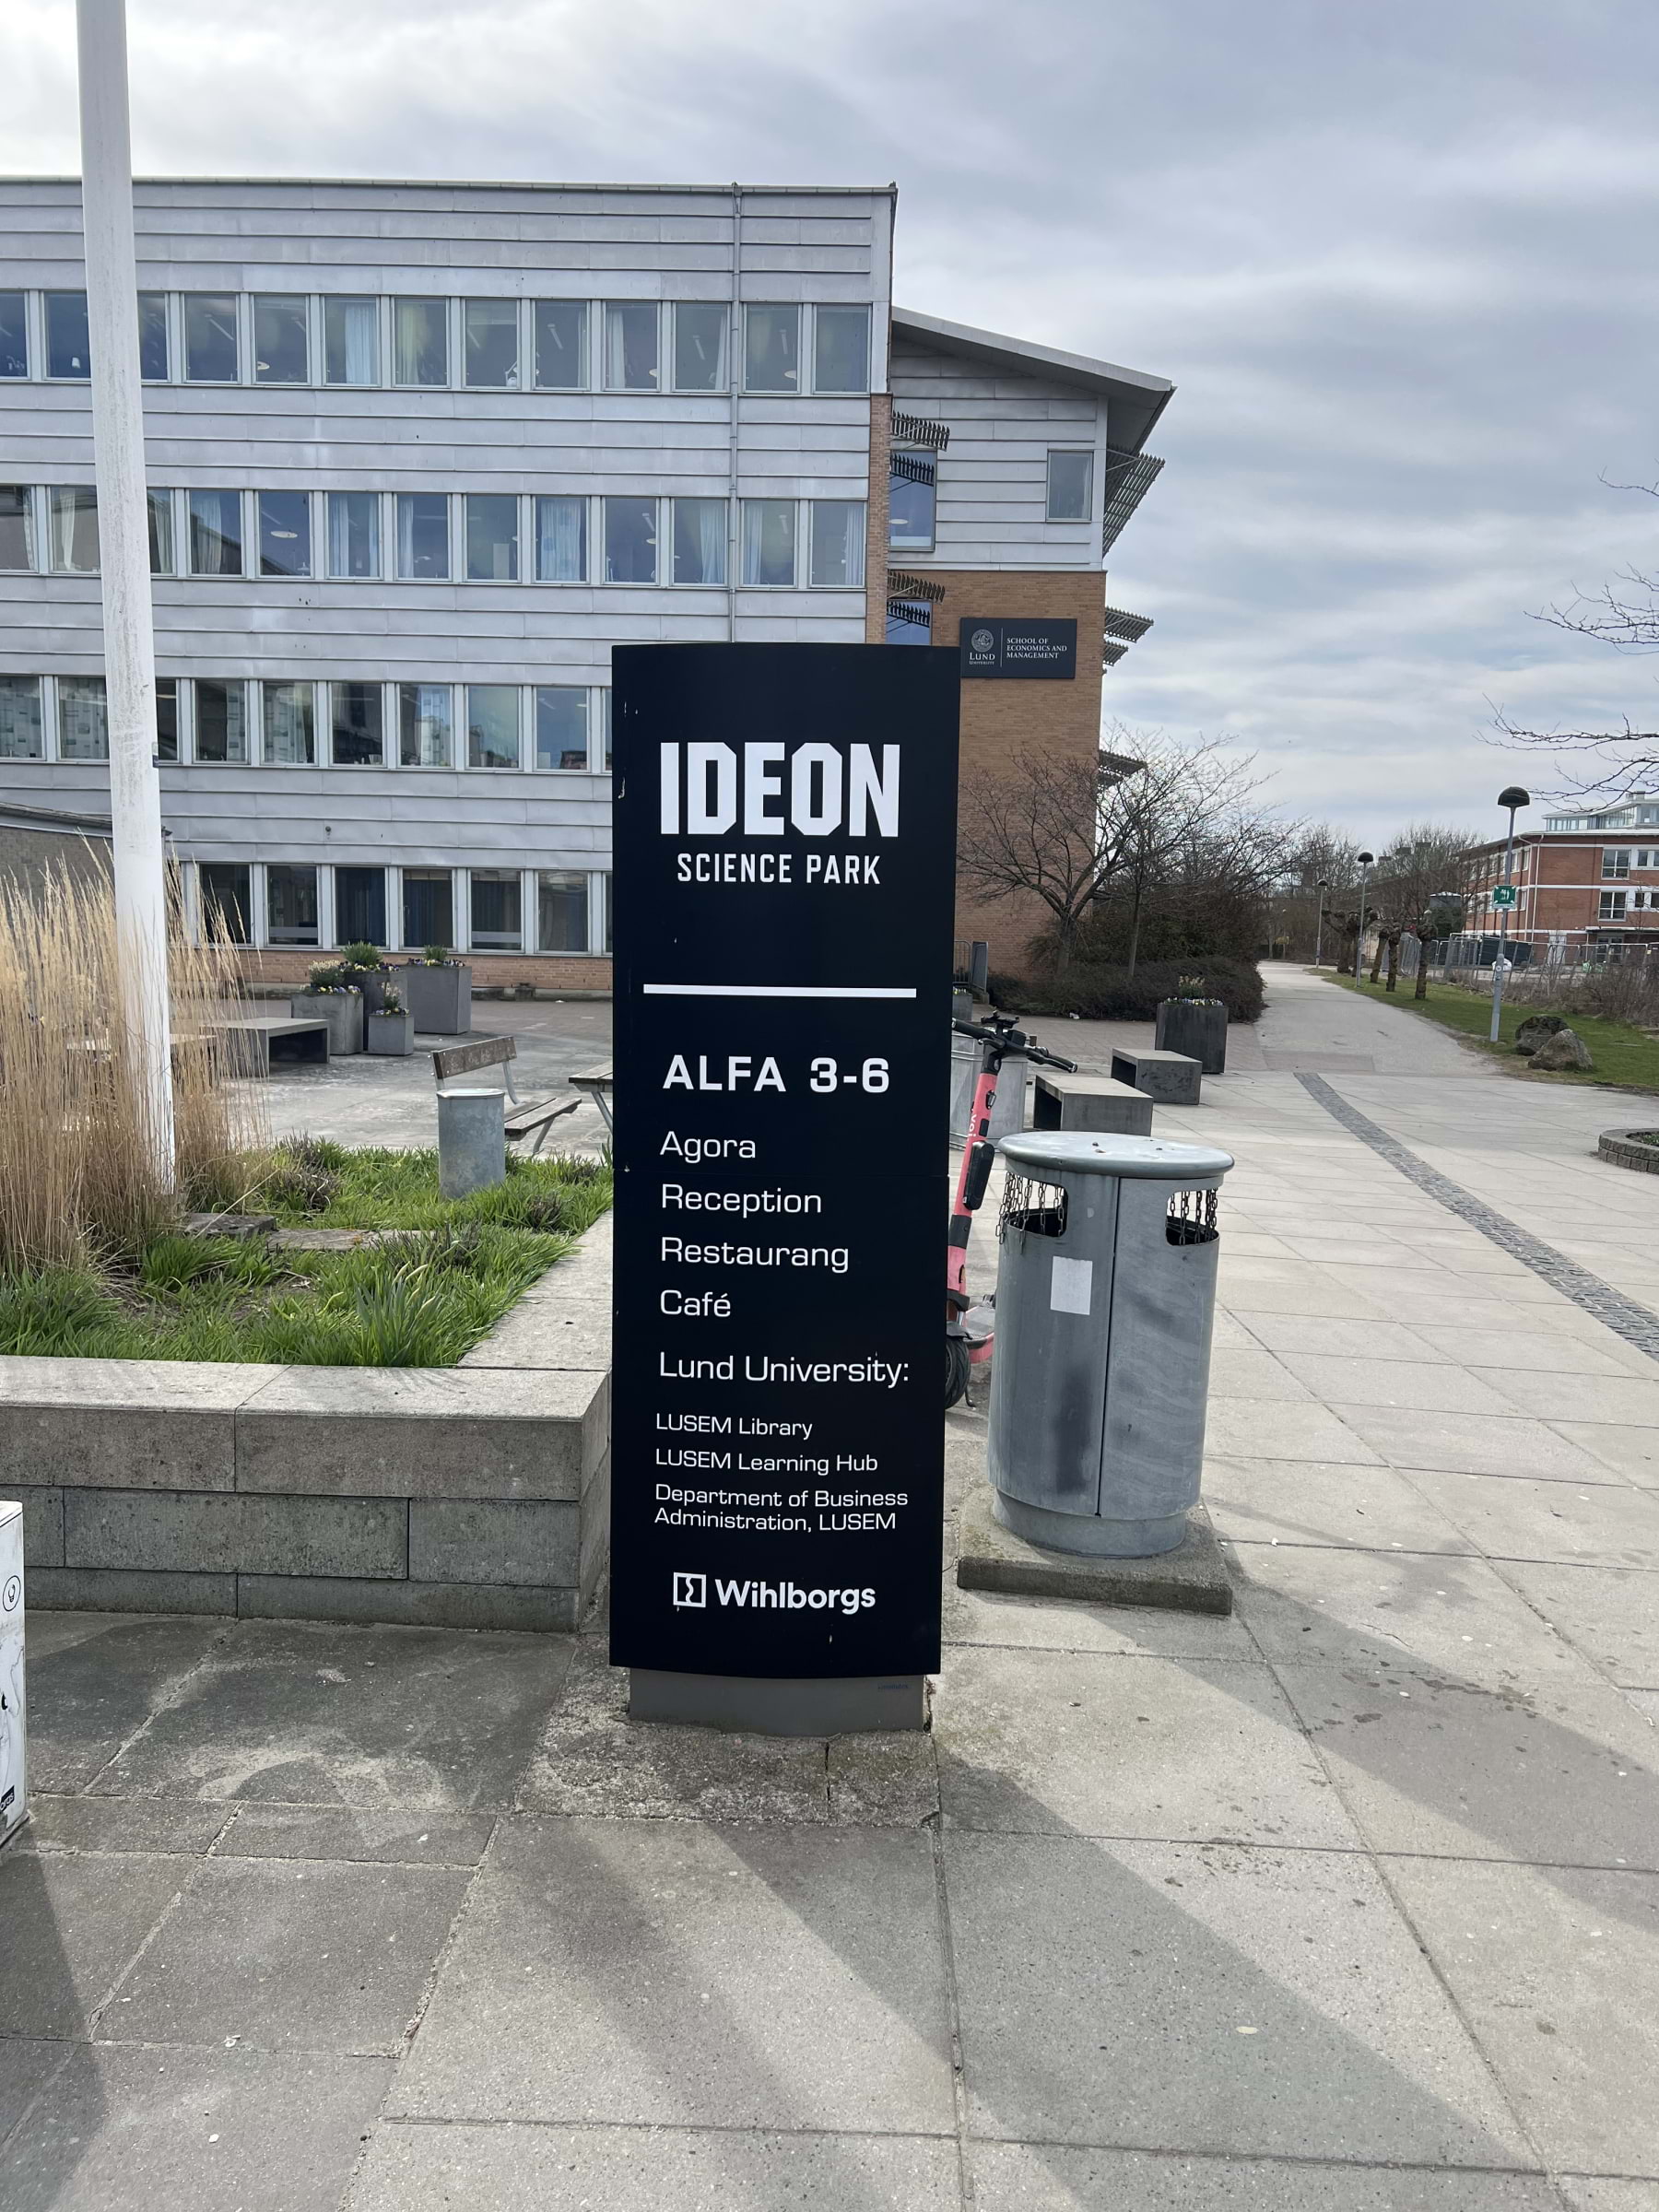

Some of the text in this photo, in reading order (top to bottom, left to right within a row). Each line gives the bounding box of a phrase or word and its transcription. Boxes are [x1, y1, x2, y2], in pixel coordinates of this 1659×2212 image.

[969, 652, 995, 660] LUND
[661, 742, 900, 837] IDEON
[677, 853, 880, 884] SCIENCE PARK
[663, 1055, 889, 1093] ALFA 3-6
[660, 1131, 756, 1163] Agora
[662, 1183, 821, 1218] Reception
[661, 1236, 849, 1274] Restaurang
[660, 1289, 731, 1317] Café
[660, 1352, 909, 1388] Lund University:
[656, 1413, 813, 1441] LUSEM Library
[655, 1449, 878, 1476] LUSEM Learning Hub
[655, 1484, 908, 1510] Department of Business
[654, 1508, 896, 1533] Administration, LUSEM
[714, 1579, 876, 1615] Wihlborgs
